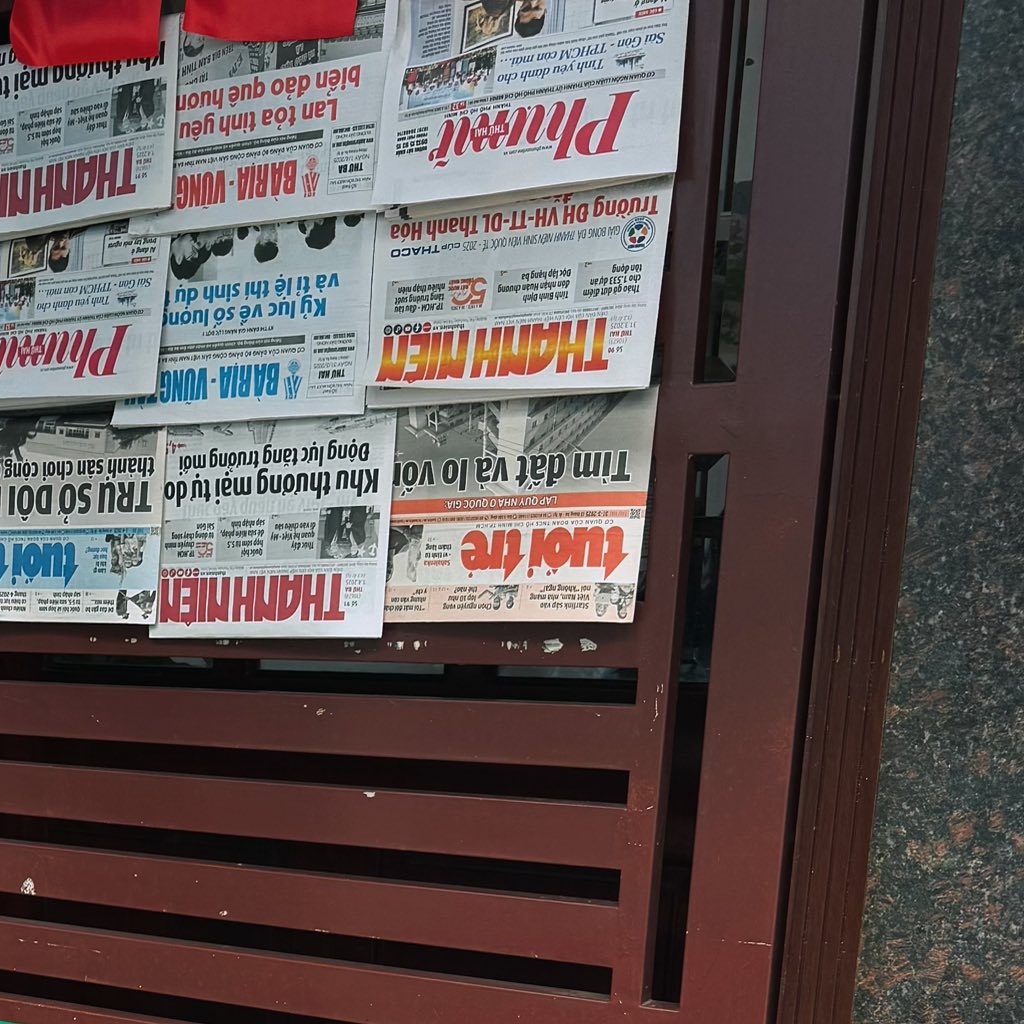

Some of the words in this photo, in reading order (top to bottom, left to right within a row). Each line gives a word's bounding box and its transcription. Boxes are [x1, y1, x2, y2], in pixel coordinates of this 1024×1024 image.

[618, 36, 641, 50] Gòn
[644, 31, 665, 46] Sài
[537, 51, 557, 62] còn
[560, 43, 607, 59] TPHCM
[553, 60, 575, 75] yêu
[577, 59, 603, 74] Tình
[316, 64, 361, 97] biển
[497, 73, 517, 84] cho
[520, 66, 550, 82] dành
[596, 76, 611, 85] LUẬN
[611, 74, 628, 84] NGÔN
[629, 72, 646, 80] QUAN
[271, 74, 310, 101] đảo
[535, 85, 554, 94] THÀNH
[555, 83, 563, 93] ỦY
[564, 81, 583, 90] THÀNH
[583, 79, 595, 88] CỦA
[228, 76, 266, 108] quê
[503, 92, 514, 101] CHÍ
[514, 90, 523, 100] HỒ
[523, 88, 535, 98] PHỐ
[302, 98, 337, 122] Lan
[219, 113, 256, 137] tình
[261, 105, 296, 131] tỏa
[179, 112, 215, 142] yêu
[474, 127, 487, 137] HAI
[489, 123, 504, 136] THỨ
[338, 164, 347, 174] BA
[348, 162, 363, 173] THỨ
[33, 147, 136, 213] THANH
[237, 162, 269, 201] RỊA
[271, 160, 297, 202] BÀ
[176, 170, 225, 209] VŨNG
[593, 195, 658, 218] Trường
[482, 207, 558, 234] VH-TT-DL
[562, 203, 589, 225] ĐH
[390, 221, 422, 243] Hóa
[426, 215, 478, 241] Thanh
[577, 229, 586, 241] ĐÁ
[588, 227, 606, 237] BÓNG
[608, 226, 620, 239] GIẢI
[508, 236, 521, 247] VIÊN
[523, 234, 538, 245] SINH
[538, 233, 553, 244] NIÊN
[554, 230, 575, 241] THANH
[441, 242, 460, 251] CÚP
[462, 241, 477, 252] 2025
[482, 240, 488, 252] TẾ
[491, 237, 507, 251] QUỐC
[391, 245, 440, 258] THACO
[548, 267, 558, 279] lập
[559, 268, 571, 278] Độc
[612, 262, 629, 273] đọng
[631, 264, 642, 273] tồn
[316, 273, 339, 291] và
[521, 273, 529, 281] ba
[530, 270, 547, 280] hạng
[590, 278, 598, 286] án
[599, 275, 608, 286] dự
[609, 275, 627, 285] 1.533
[629, 274, 641, 284] cho
[79, 282, 111, 294] TPHCM
[244, 280, 269, 301] thí
[274, 274, 292, 297] lệ
[296, 276, 310, 296] tỉ
[398, 286, 411, 294] niên
[413, 284, 427, 293] thập
[428, 283, 445, 291] nhiều
[498, 281, 521, 294] chương
[522, 283, 538, 293] Huân
[540, 280, 556, 290] nhận
[557, 279, 570, 289] đón
[613, 283, 622, 295] gỡ
[623, 284, 640, 294] Tháo
[174, 284, 198, 308] dự
[202, 283, 240, 304] sinh
[409, 294, 429, 302] trưởng
[430, 293, 444, 302] tăng
[523, 292, 537, 303] Định
[538, 291, 553, 301] Bình
[555, 291, 568, 300] Tỉnh
[583, 288, 600, 297] điểm
[601, 287, 612, 296] dứt
[395, 296, 408, 304] suốt
[421, 302, 443, 311] TP.HCM
[239, 303, 263, 326] về
[268, 296, 296, 320] lục
[300, 295, 326, 320] Kỷ
[394, 306, 404, 314] tàu
[405, 305, 417, 313] đầu
[213, 306, 235, 328] số
[469, 317, 608, 378] THANH
[375, 330, 469, 384] NIÊN
[219, 363, 252, 399] RỊA
[318, 370, 330, 379] HAI
[331, 369, 345, 379] THỨ
[160, 368, 207, 405] VŨNG
[254, 363, 280, 402] BÀ
[263, 444, 297, 466] tăng
[301, 441, 323, 466] lực
[327, 439, 369, 462] Động
[108, 457, 154, 477] thành
[179, 453, 206, 476] mới
[209, 448, 259, 473] trưởng
[572, 450, 631, 483] Tìm
[4, 458, 38, 480] cộng
[42, 460, 73, 481] chơi
[78, 459, 103, 478] sân
[441, 458, 468, 491] lo
[475, 457, 508, 489] và
[516, 453, 566, 490] đất
[190, 473, 211, 503] tự
[215, 472, 251, 505] mại
[257, 468, 330, 499] thương
[335, 468, 379, 497] Khu
[98, 476, 152, 513] TRỤ
[164, 480, 187, 507] do
[8, 485, 52, 522] DÔI
[57, 483, 92, 524] SỞ
[461, 529, 525, 581] trẻ
[527, 526, 629, 581] tuổi
[11, 543, 78, 588] tuổi
[160, 576, 230, 627] NIÊN
[231, 573, 344, 622] THANH
